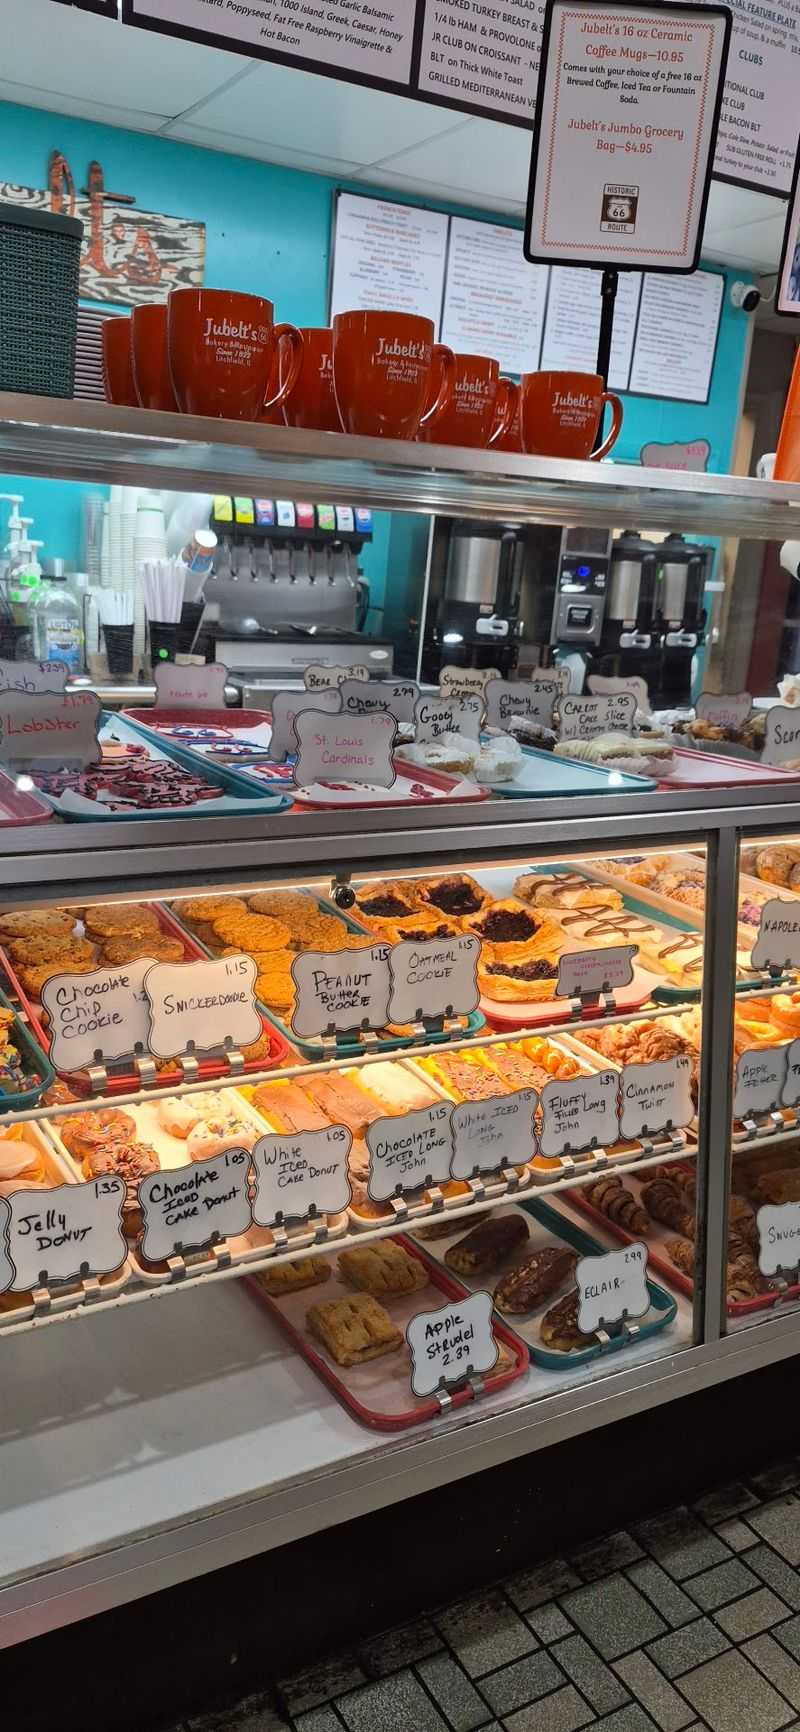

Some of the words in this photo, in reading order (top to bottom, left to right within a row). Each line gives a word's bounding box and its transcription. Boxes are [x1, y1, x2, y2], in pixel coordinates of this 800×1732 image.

[339, 0, 361, 11] Garlic
[362, 5, 395, 21] Balsamic
[472, 3, 501, 20] TURKEY
[502, 13, 530, 29] BREAST
[531, 22, 538, 32] &
[747, 4, 777, 21] FEATURE
[776, 14, 797, 29] PLATE
[281, 0, 299, 11] 1000
[326, 12, 350, 26] Greek,
[379, 27, 404, 41] Honey
[260, 27, 275, 38] Hot
[276, 31, 300, 45] Bacon
[273, 13, 286, 25] Fat
[287, 17, 304, 30] Free
[304, 22, 342, 41] Raspberry
[345, 33, 384, 51] Vinaigrette
[385, 45, 393, 53] &
[434, 12, 447, 24] 1/4
[448, 15, 457, 26] lb
[458, 19, 477, 33] HAM
[480, 26, 489, 36] &
[489, 28, 536, 51] PROVOLONE
[581, 22, 620, 35] Jubelt's
[623, 25, 635, 37] 16
[636, 28, 649, 38] oz
[650, 28, 693, 41] Ceramic
[432, 32, 441, 42] JR
[443, 35, 463, 49] CLUB
[464, 42, 477, 53] ON
[478, 45, 522, 65] CROISSANT
[585, 44, 617, 59] Coffee
[738, 49, 764, 66] CLUBS
[430, 51, 446, 63] BLT
[447, 58, 458, 67] on
[460, 59, 479, 73] Thick
[480, 65, 503, 79] White
[504, 71, 523, 85] Toast
[563, 62, 588, 72] Comes
[588, 65, 606, 74] with
[607, 68, 625, 77] your
[626, 68, 651, 78] choice
[652, 69, 661, 80] of
[666, 71, 682, 82] free
[683, 73, 692, 81] 16
[693, 74, 703, 82] oz
[429, 71, 460, 88] GRILLED
[461, 80, 526, 105] MEDITERRANEAN
[567, 76, 595, 88] Brewed
[595, 78, 620, 91] Coffee,
[621, 80, 637, 90] Iced
[638, 82, 652, 92] Tea
[652, 84, 662, 93] or
[662, 84, 696, 95] Fountain
[749, 88, 765, 100] CLUB
[619, 95, 639, 105] Soda.
[729, 98, 745, 111] CLUB
[568, 119, 606, 132] Jubelt's
[607, 122, 642, 135] Jumbo
[644, 124, 684, 140] Grocery
[728, 115, 750, 129] BACON
[607, 186, 636, 195] HISTORIC
[612, 207, 626, 218] 66
[607, 223, 628, 232] ROUTE
[203, 317, 257, 341] Jubelt's
[375, 337, 424, 360] Jubelt's
[455, 375, 489, 395] ubelt's
[551, 391, 592, 409] Jubelt's
[0, 675, 37, 692] ish
[7, 713, 82, 735] Lobster
[334, 735, 363, 747] Louis
[321, 750, 376, 767] Cardinals
[370, 948, 389, 961] 1.15
[409, 950, 457, 968] OATMEAL
[225, 961, 249, 976] 1.15
[312, 970, 372, 992] PEANUT
[132, 991, 149, 1002] 1.2
[429, 1107, 446, 1121] 1.15
[327, 1130, 346, 1142] 1.05
[554, 1120, 580, 1135] John
[419, 1137, 446, 1155] LONG
[224, 1151, 246, 1166] 1.05
[263, 1146, 302, 1165] White
[399, 1157, 426, 1174] John
[94, 1180, 121, 1199] 1.35
[18, 1209, 66, 1237] Jelly
[442, 1345, 471, 1367] 2.39
